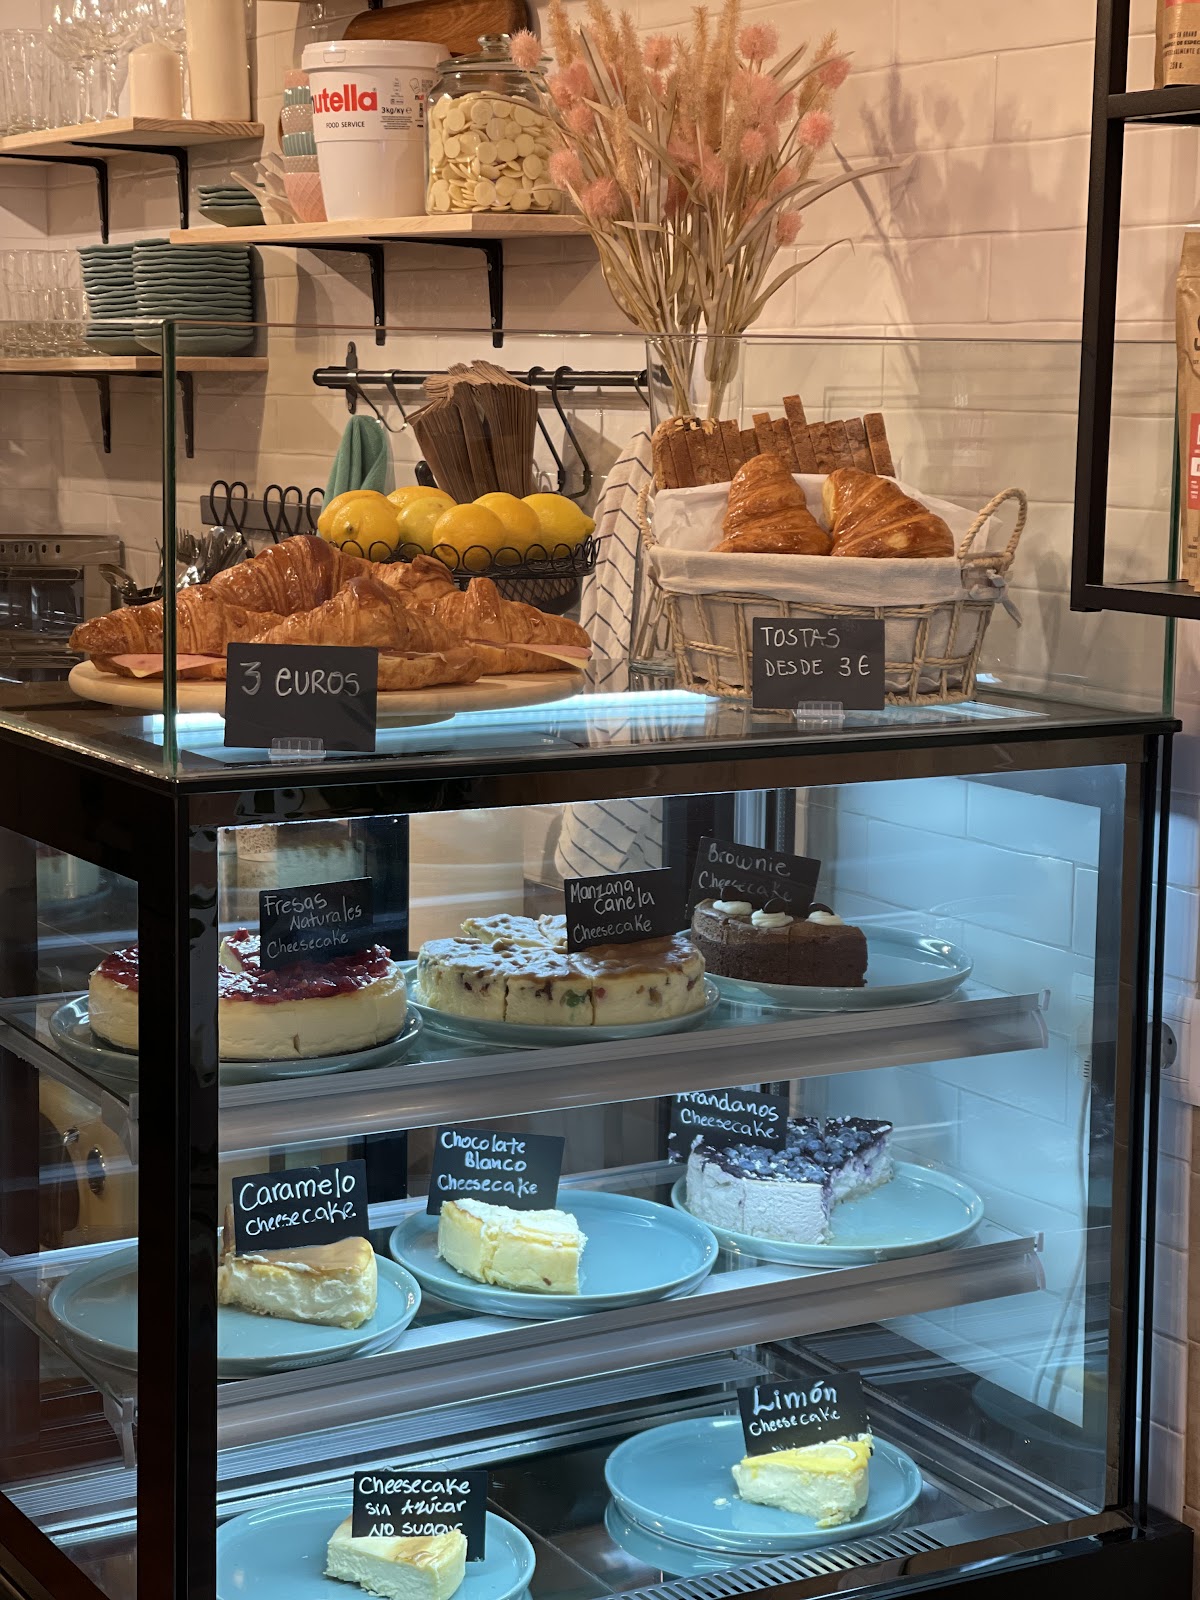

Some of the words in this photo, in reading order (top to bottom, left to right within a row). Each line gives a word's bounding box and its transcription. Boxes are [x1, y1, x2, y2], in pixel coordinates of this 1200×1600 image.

[325, 121, 340, 129] FOOD
[760, 626, 841, 649] TOSTAS
[239, 661, 262, 696] 3
[764, 658, 824, 677] DESDE
[707, 842, 791, 877] Brownie
[570, 879, 635, 903] Manzana
[263, 892, 328, 916] Fresas
[289, 895, 363, 931] Naturales
[573, 913, 653, 944] Cheesecake
[266, 928, 349, 959] Cheesecake
[680, 1108, 780, 1139] Cheesecake
[440, 1130, 527, 1155] Chocolate
[464, 1150, 528, 1172] Blanco
[239, 1167, 356, 1212] Caramelo
[436, 1173, 539, 1198] Cheesecake
[752, 1380, 838, 1416] Limón
[358, 1476, 472, 1496] Cheesecake
